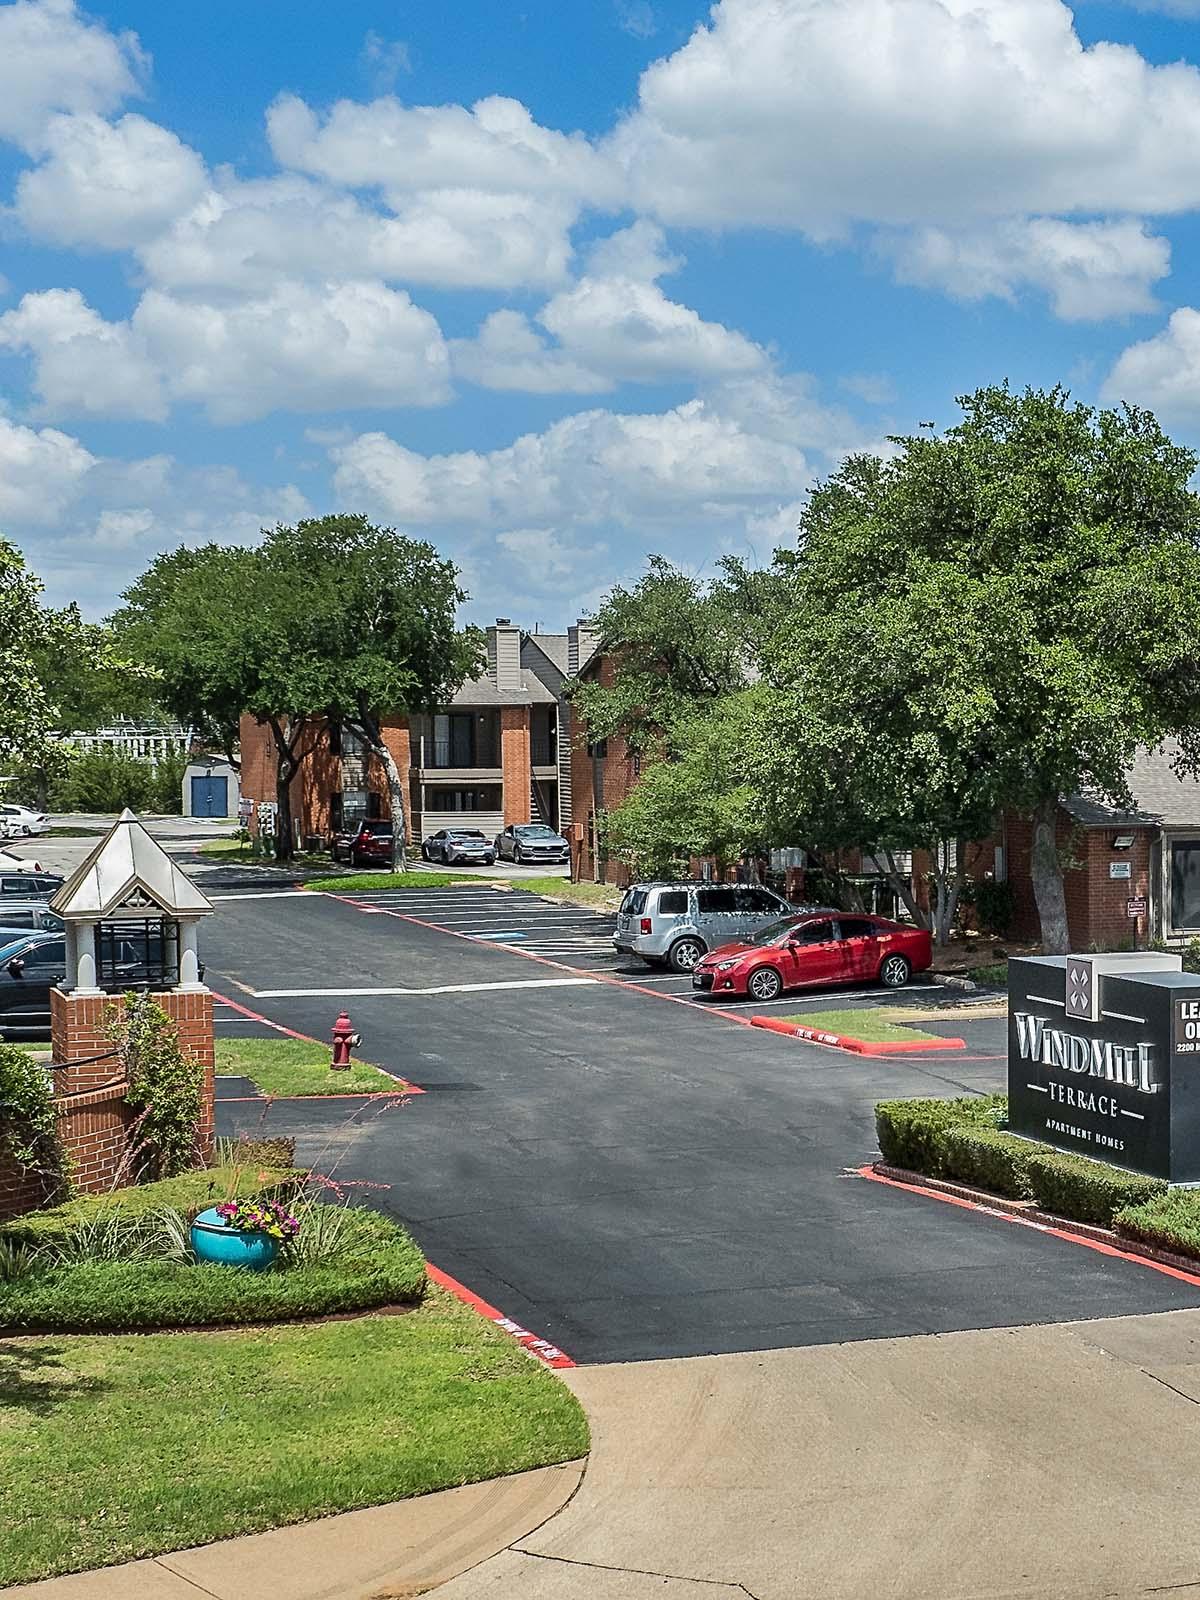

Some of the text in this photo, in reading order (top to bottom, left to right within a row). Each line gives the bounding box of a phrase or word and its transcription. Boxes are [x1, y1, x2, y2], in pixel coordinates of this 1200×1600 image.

[1176, 1043, 1195, 1052] 2200
[1048, 1082, 1118, 1118] TERRACE
[1045, 1118, 1125, 1151] APARTMENT HOMES
